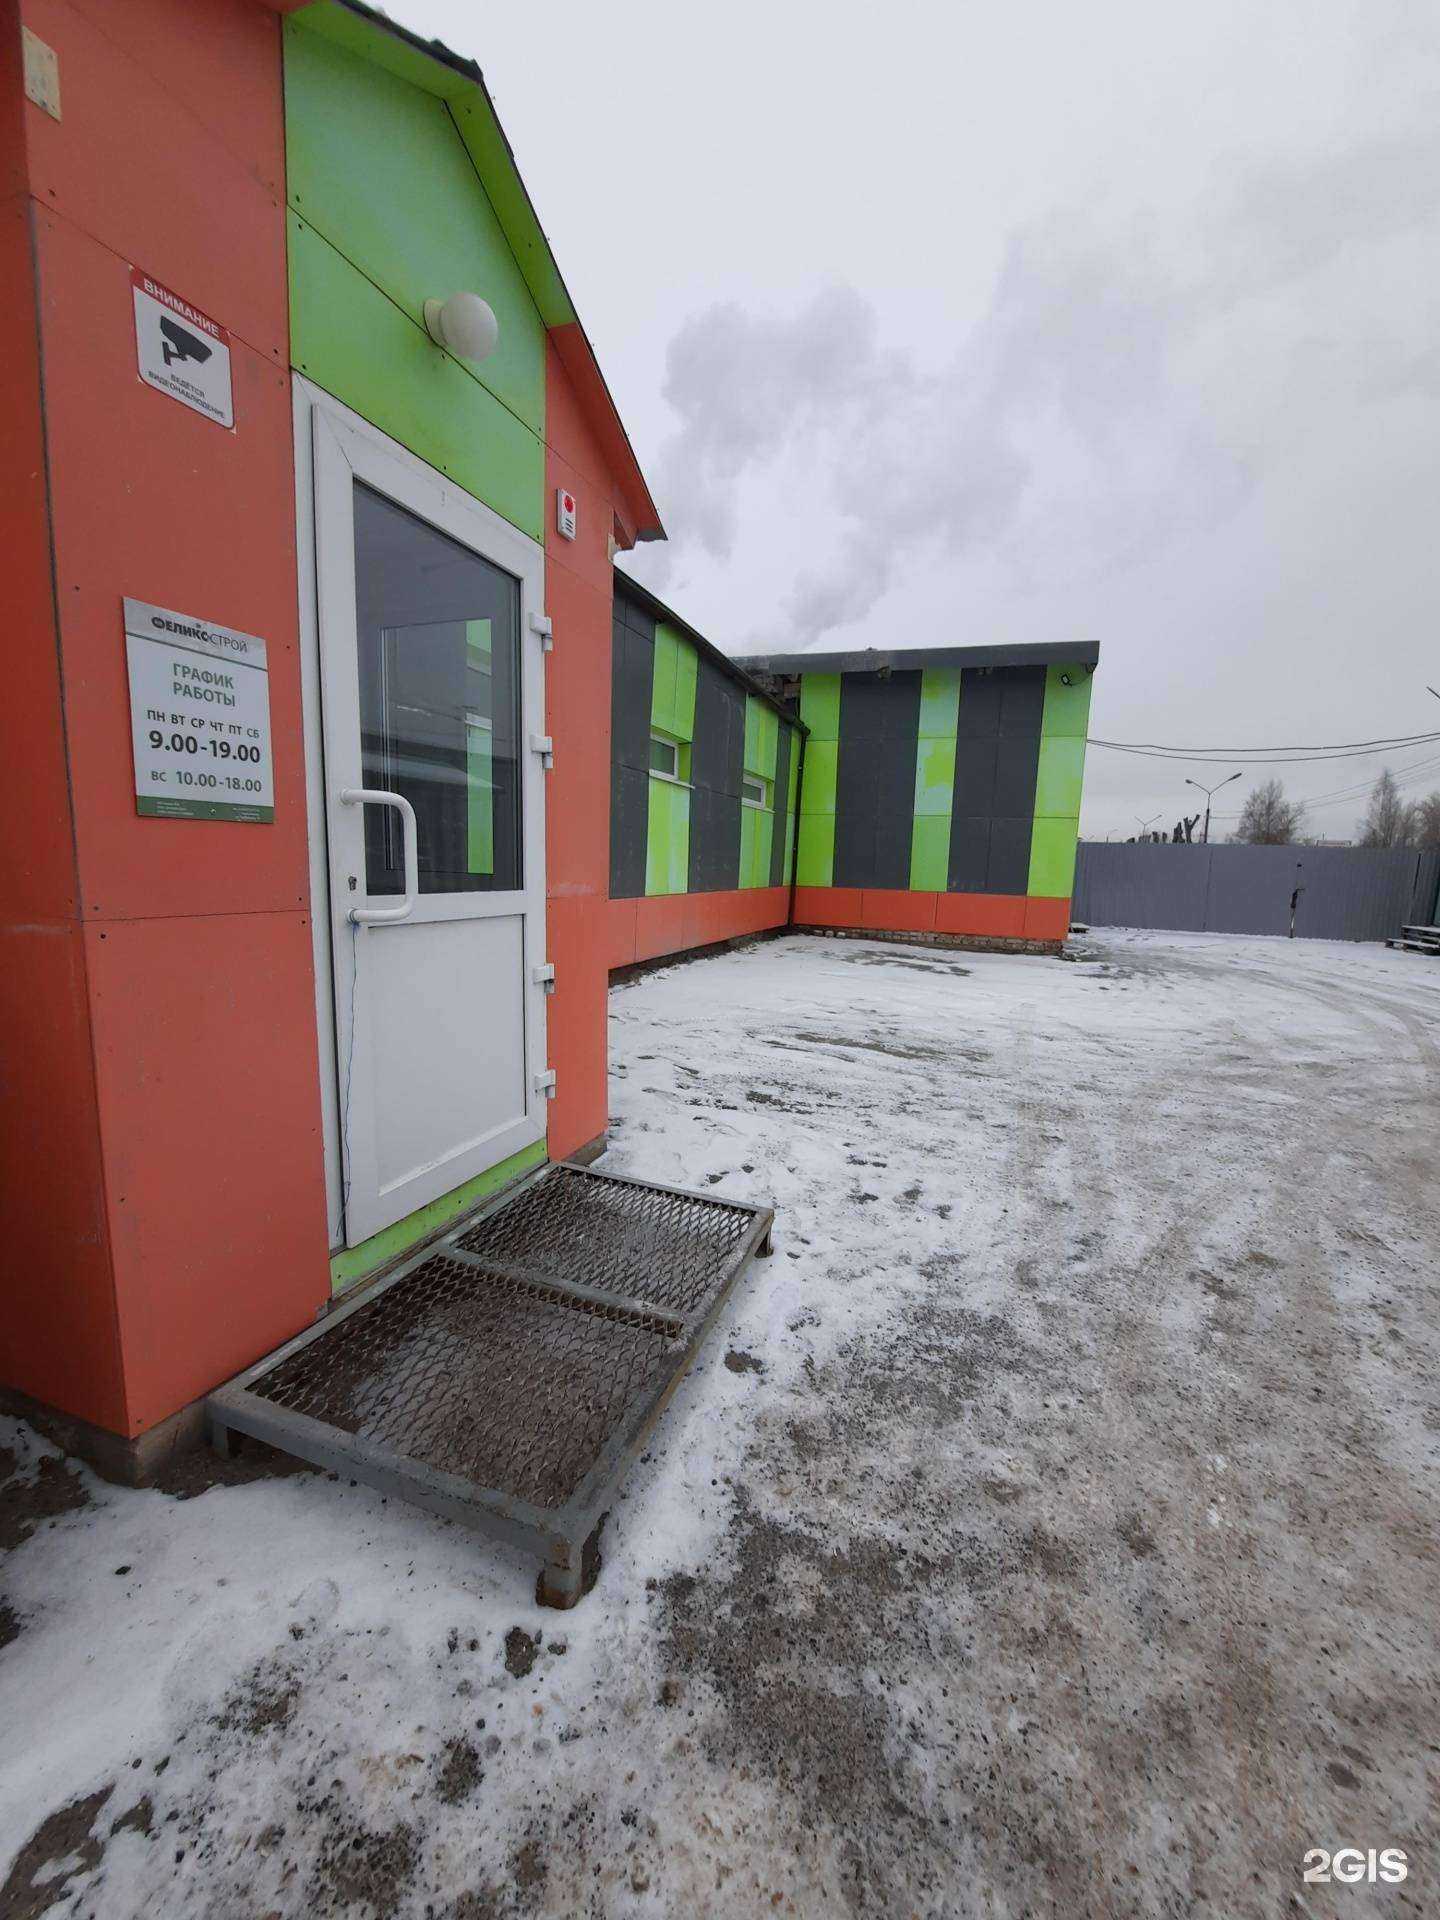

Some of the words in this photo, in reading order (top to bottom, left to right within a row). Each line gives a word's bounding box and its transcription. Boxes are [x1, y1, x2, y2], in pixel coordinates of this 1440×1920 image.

[144, 278, 220, 338] ВНИМАНИЕ
[173, 662, 234, 690] ГРАФИК
[173, 682, 236, 707] РАБОТЫ
[147, 709, 166, 723] ПН
[171, 713, 186, 726] ВТ
[190, 717, 205, 729] СР
[210, 721, 224, 733] ЧТ
[229, 724, 243, 736] ПТ
[246, 728, 260, 739] СБ
[151, 771, 167, 782] ВС
